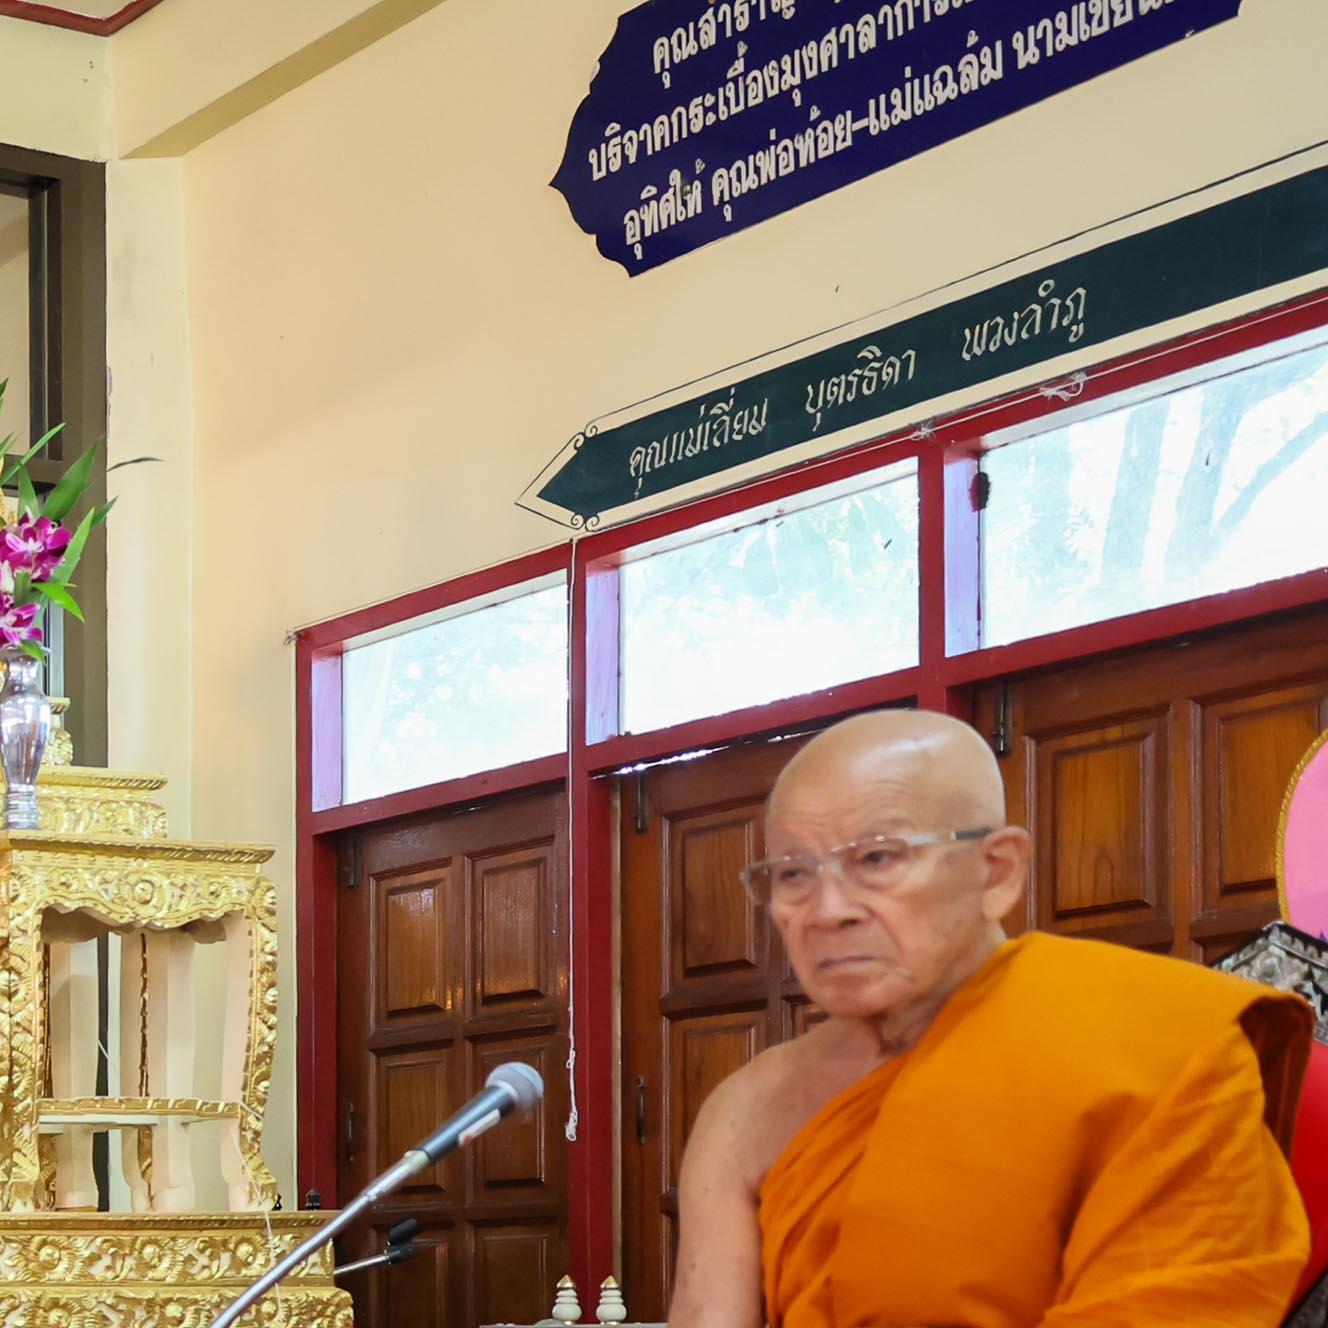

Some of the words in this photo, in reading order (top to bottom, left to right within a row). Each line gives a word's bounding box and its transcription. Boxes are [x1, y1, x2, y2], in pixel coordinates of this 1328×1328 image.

[623, 158, 706, 260] อุทิศให้
[712, 29, 1003, 222] คุณพ่อห้อย-แม่แฉล้ม
[804, 345, 916, 432] บุตรธิดา
[961, 279, 1087, 362] พวงลำภู
